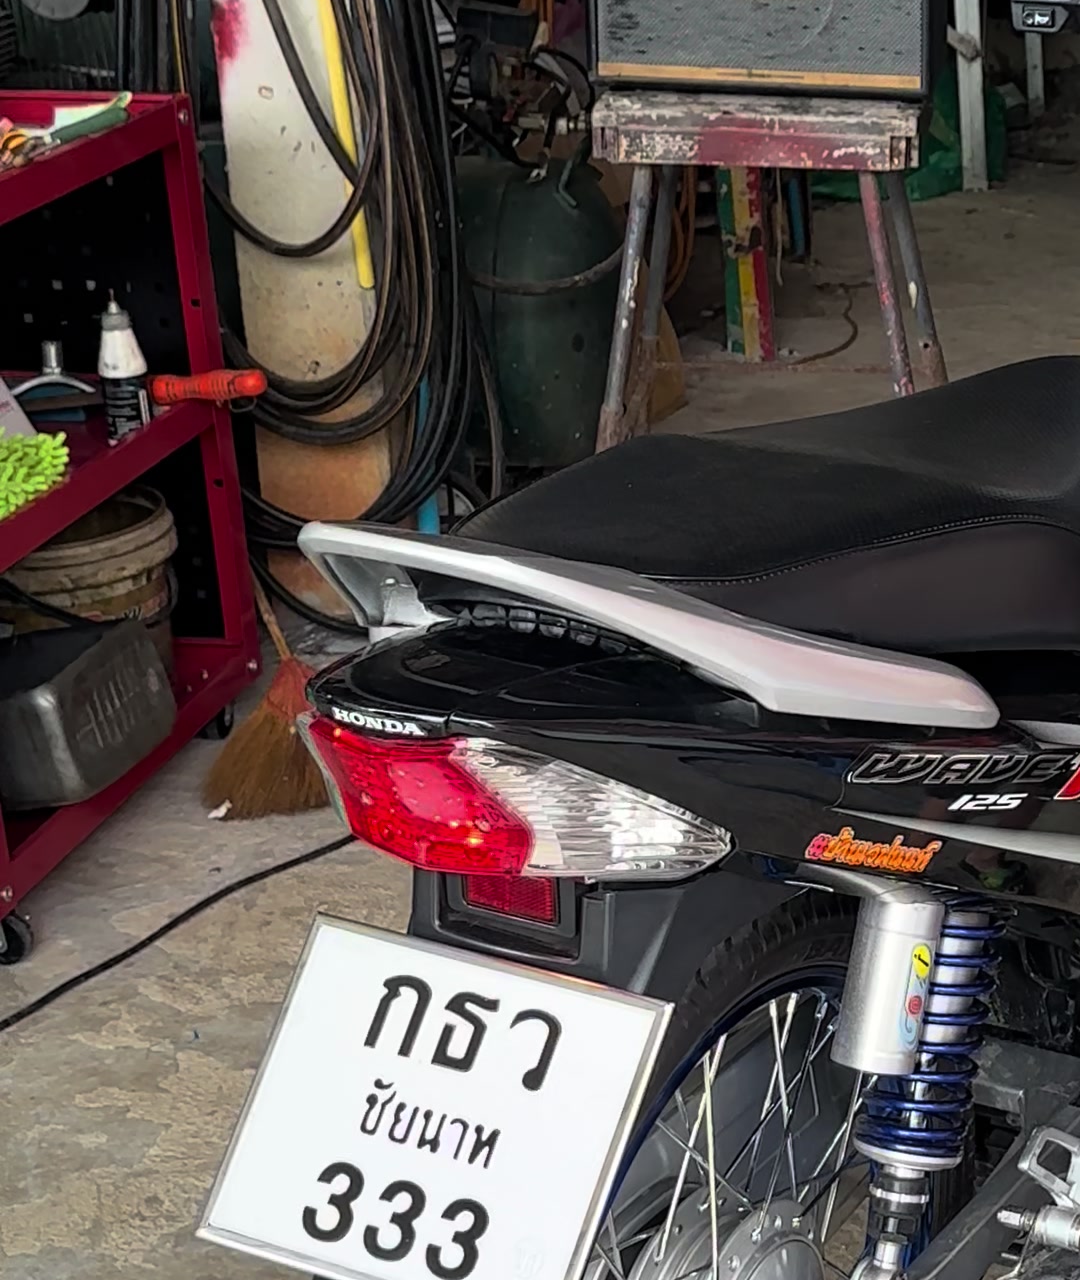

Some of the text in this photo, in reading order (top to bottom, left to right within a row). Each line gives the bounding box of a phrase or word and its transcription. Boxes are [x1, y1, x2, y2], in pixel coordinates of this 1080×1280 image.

[331, 706, 428, 737] HONDA
[947, 793, 1028, 811] 125
[363, 975, 563, 1091] กธว
[360, 1078, 501, 1169] ชัยนาท
[302, 1161, 490, 1280] 333
